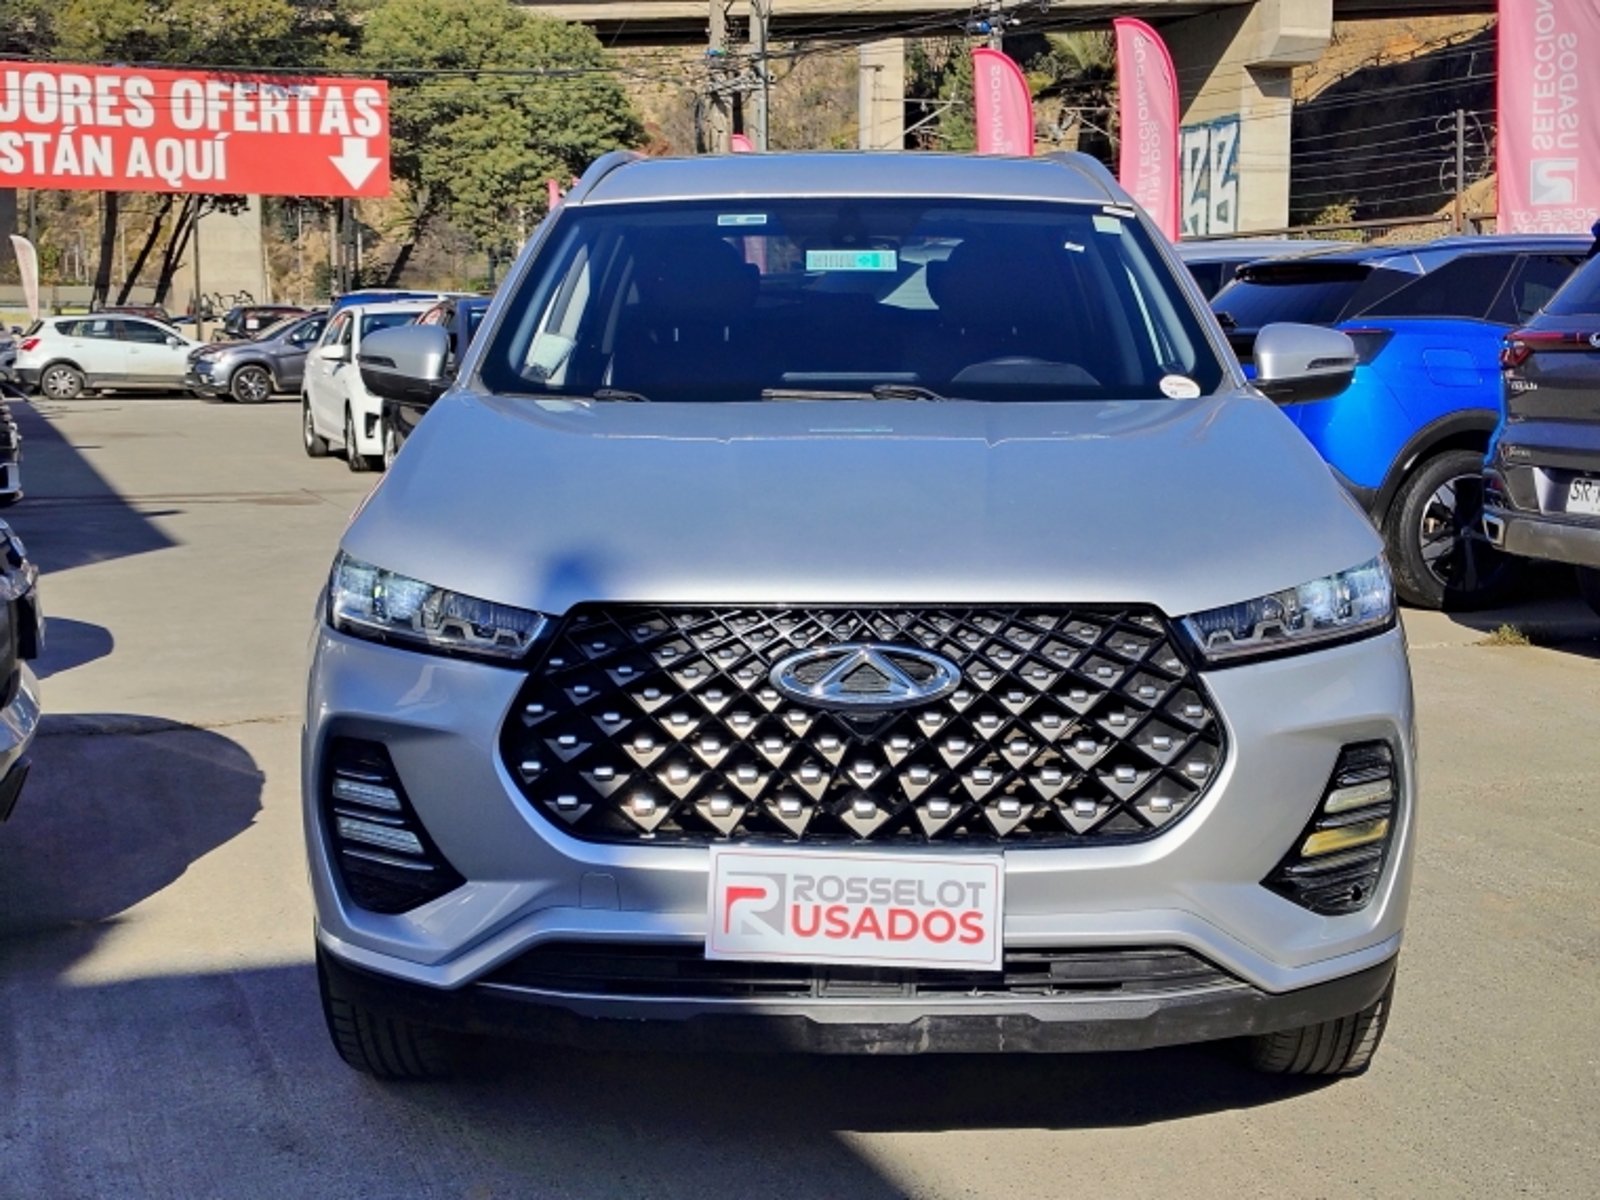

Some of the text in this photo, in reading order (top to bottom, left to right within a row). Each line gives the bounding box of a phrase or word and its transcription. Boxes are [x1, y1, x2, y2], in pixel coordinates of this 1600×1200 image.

[0, 71, 382, 137] JORES OFERTAS
[0, 126, 231, 188] STÁN AQUÍ
[1570, 479, 1600, 503] SR
[793, 875, 986, 908] ROSSELOT
[790, 904, 985, 944] USADOS
